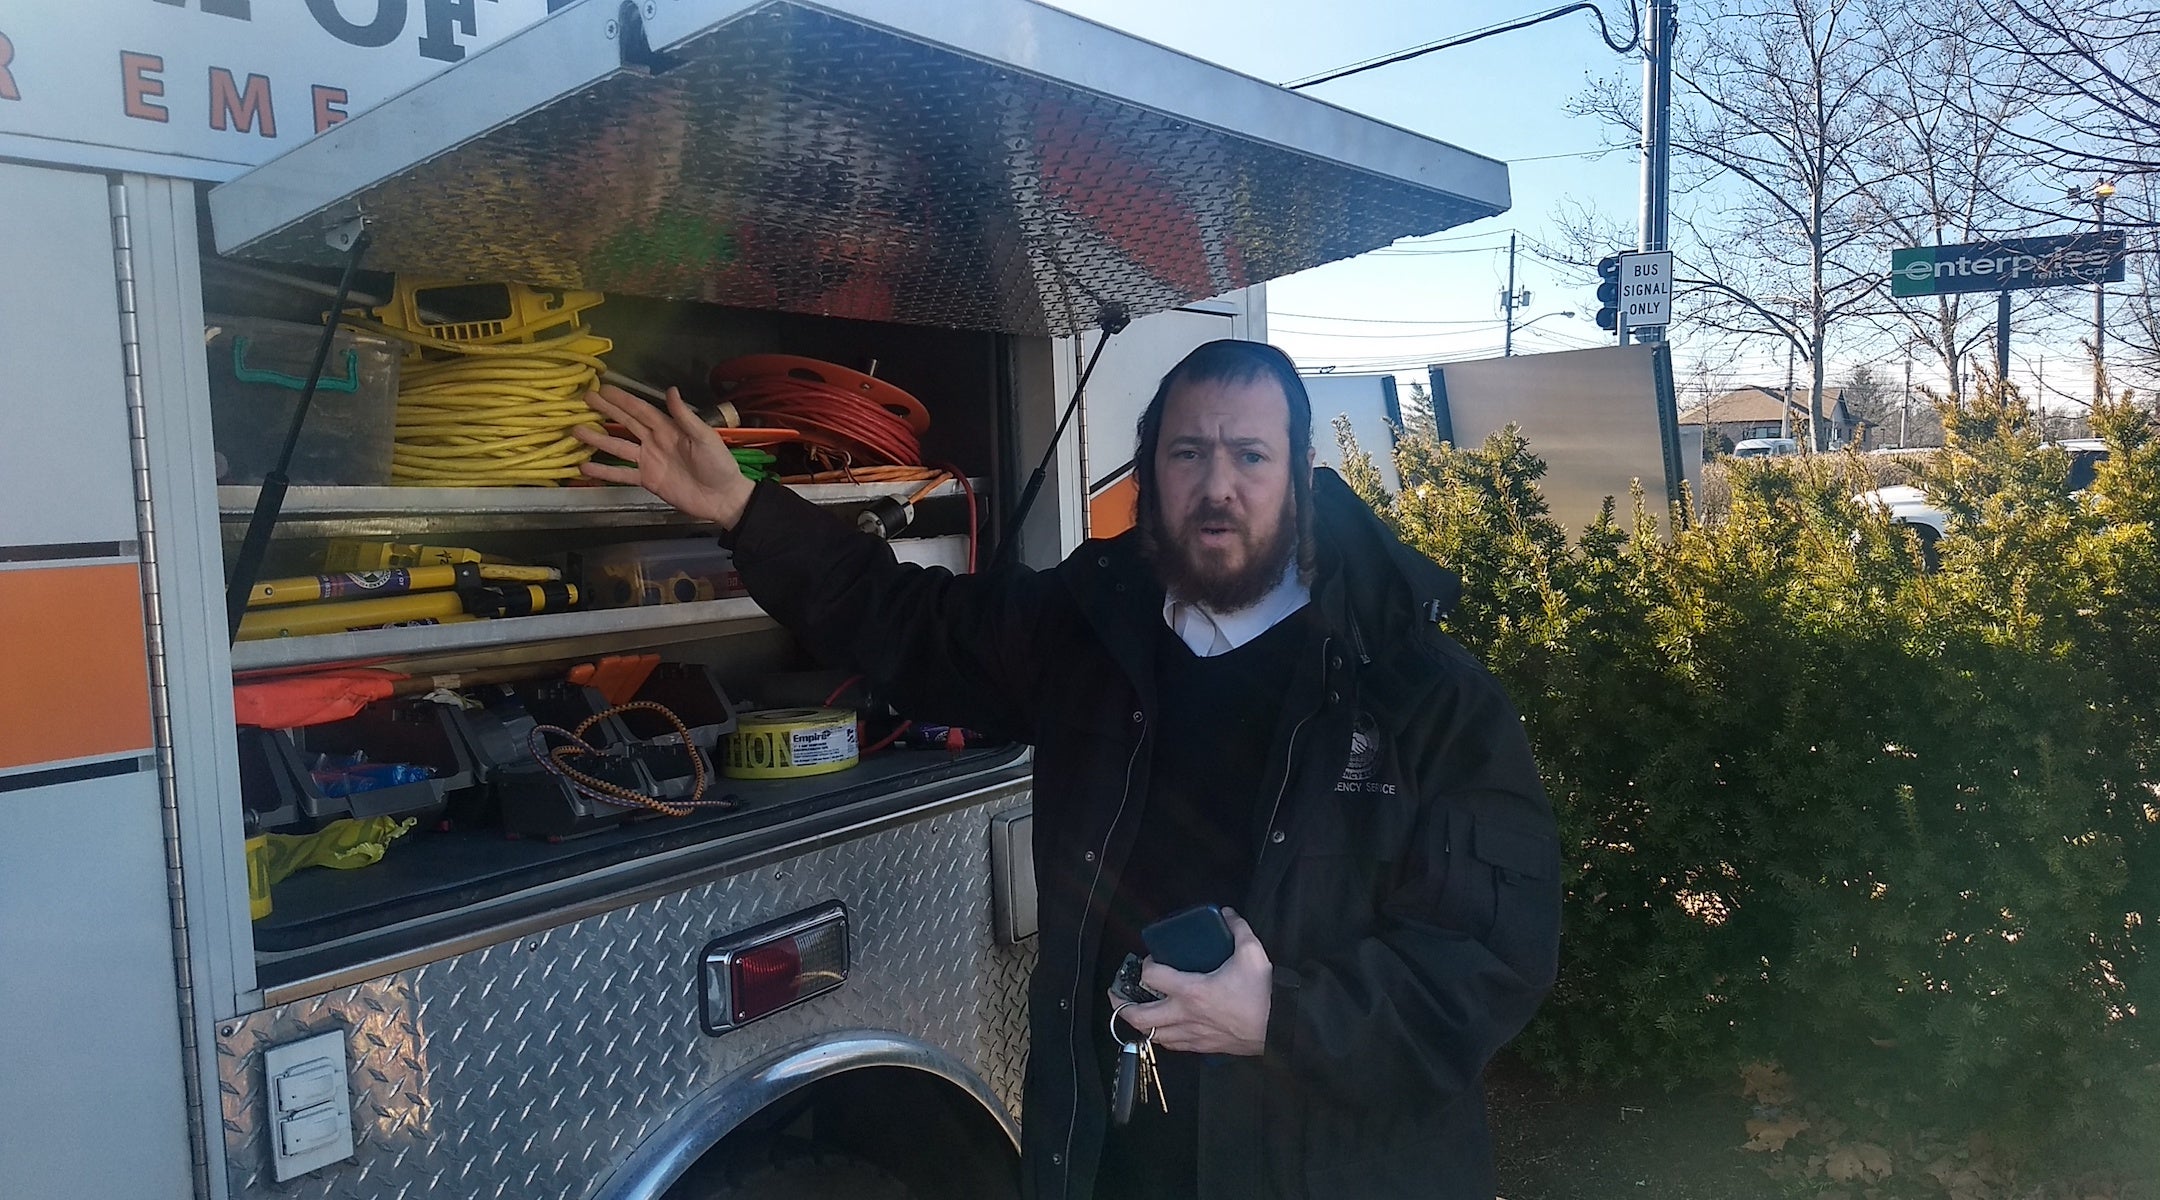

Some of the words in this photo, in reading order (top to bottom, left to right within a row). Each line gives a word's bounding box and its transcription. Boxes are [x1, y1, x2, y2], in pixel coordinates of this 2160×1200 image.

[1634, 264, 1658, 277] BUS
[1623, 282, 1668, 297] SIGNAL
[1629, 301, 1661, 316] ONLY
[793, 733, 828, 743] Empire
